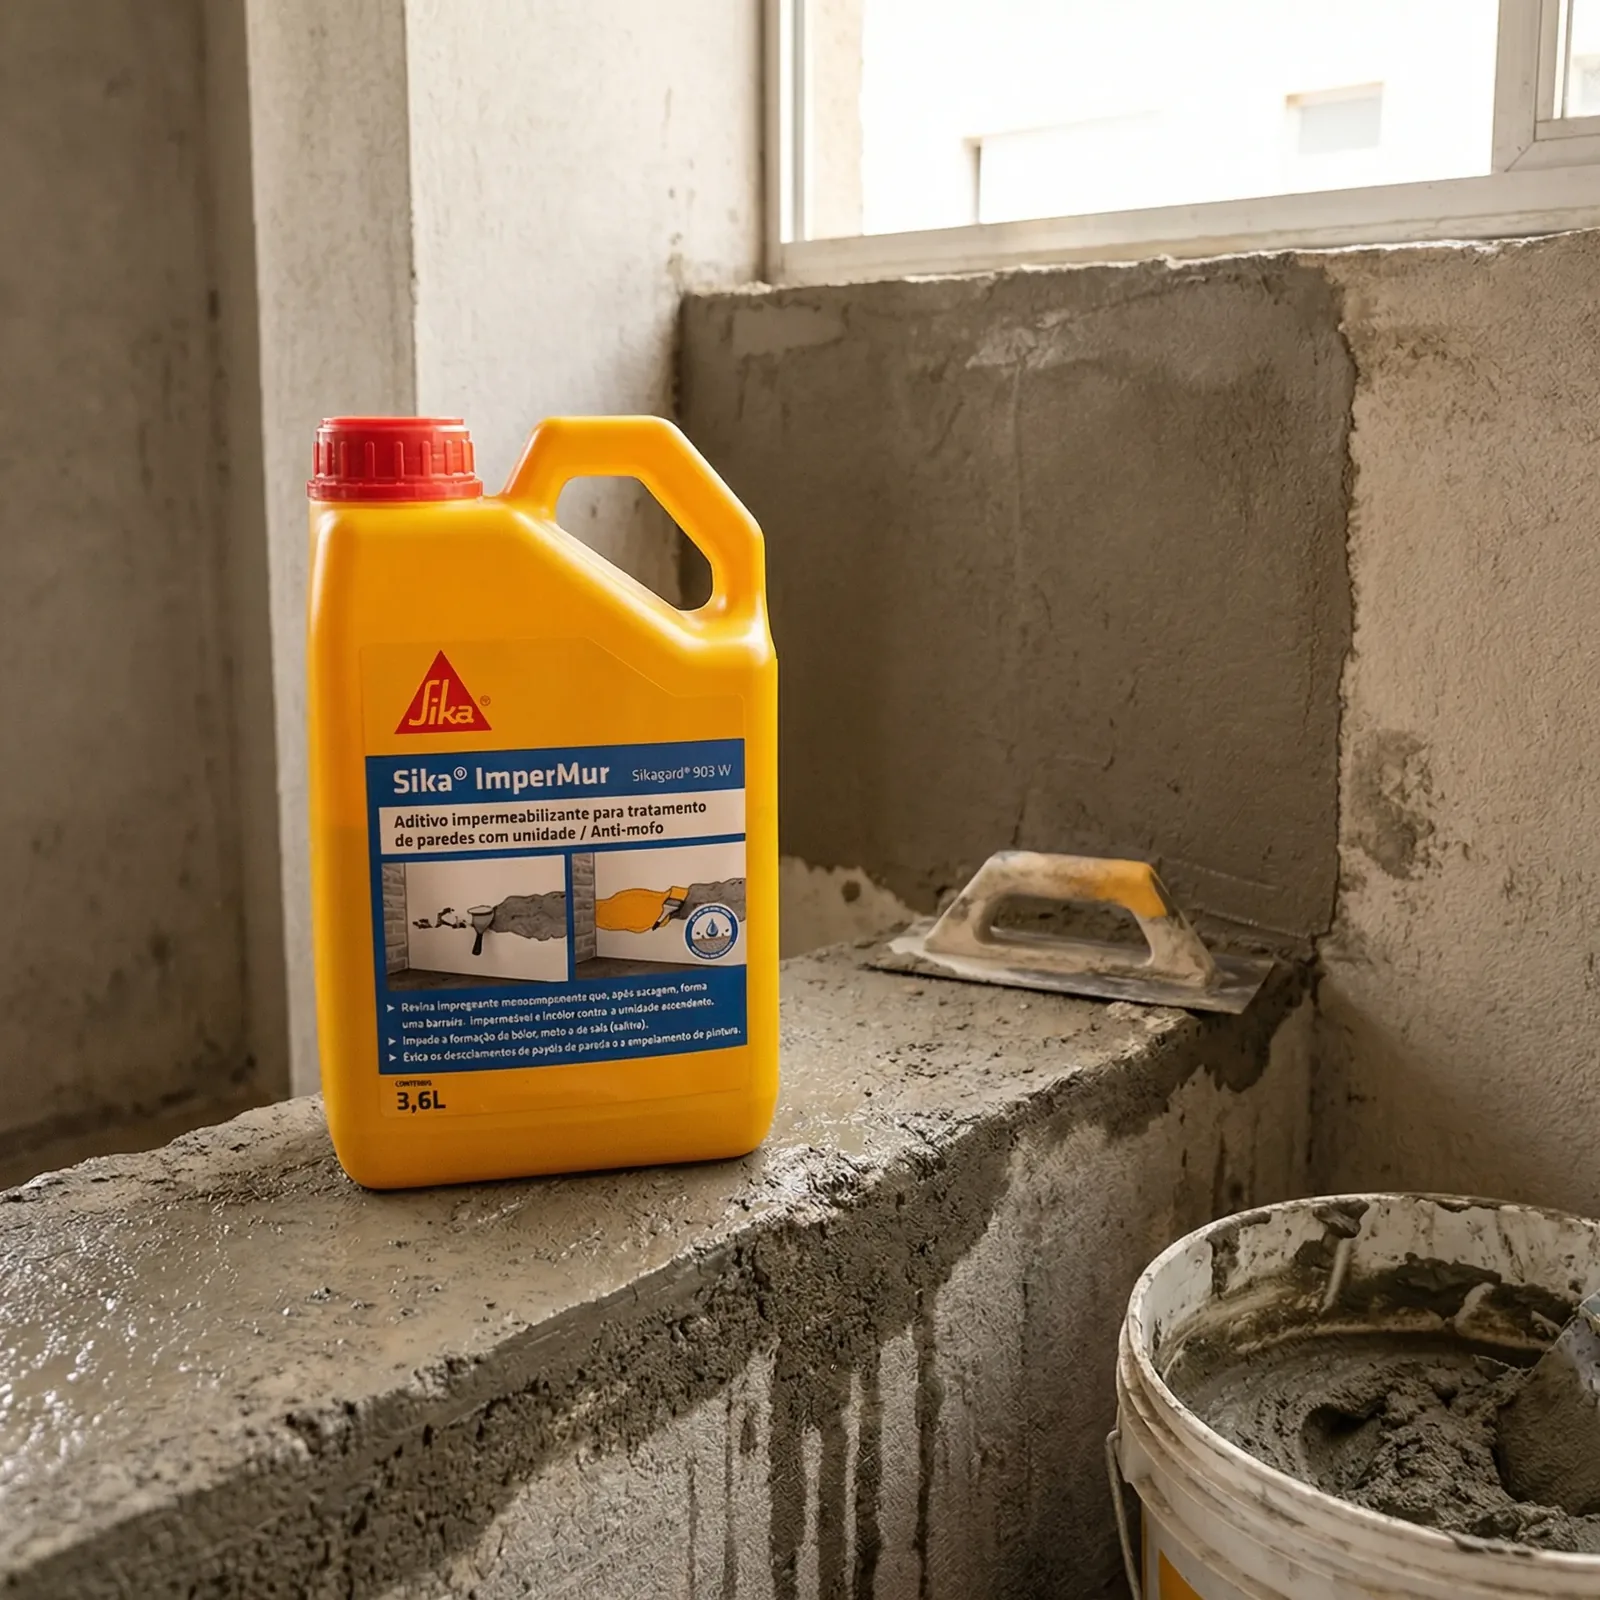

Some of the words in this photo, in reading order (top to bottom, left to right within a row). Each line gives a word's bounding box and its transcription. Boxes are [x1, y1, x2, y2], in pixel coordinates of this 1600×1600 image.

[408, 679, 474, 726] Sika
[476, 762, 610, 794] ImperMur
[693, 766, 715, 778] 903
[718, 764, 732, 777] W
[394, 814, 448, 828] Aditivo
[452, 808, 590, 828] impermeabilizante
[593, 806, 624, 822] para
[628, 801, 706, 818] tratamento
[395, 834, 413, 847] de
[418, 832, 475, 850] paredes
[478, 833, 508, 844] com
[580, 826, 586, 840] /
[590, 820, 664, 838] Anti-mofo
[680, 982, 708, 992] forma
[576, 1008, 608, 1018] contra
[518, 1046, 530, 1056] de
[564, 1042, 576, 1052] de
[692, 1029, 704, 1040] de
[576, 1026, 588, 1034] de
[396, 1090, 446, 1114] 3,6L
